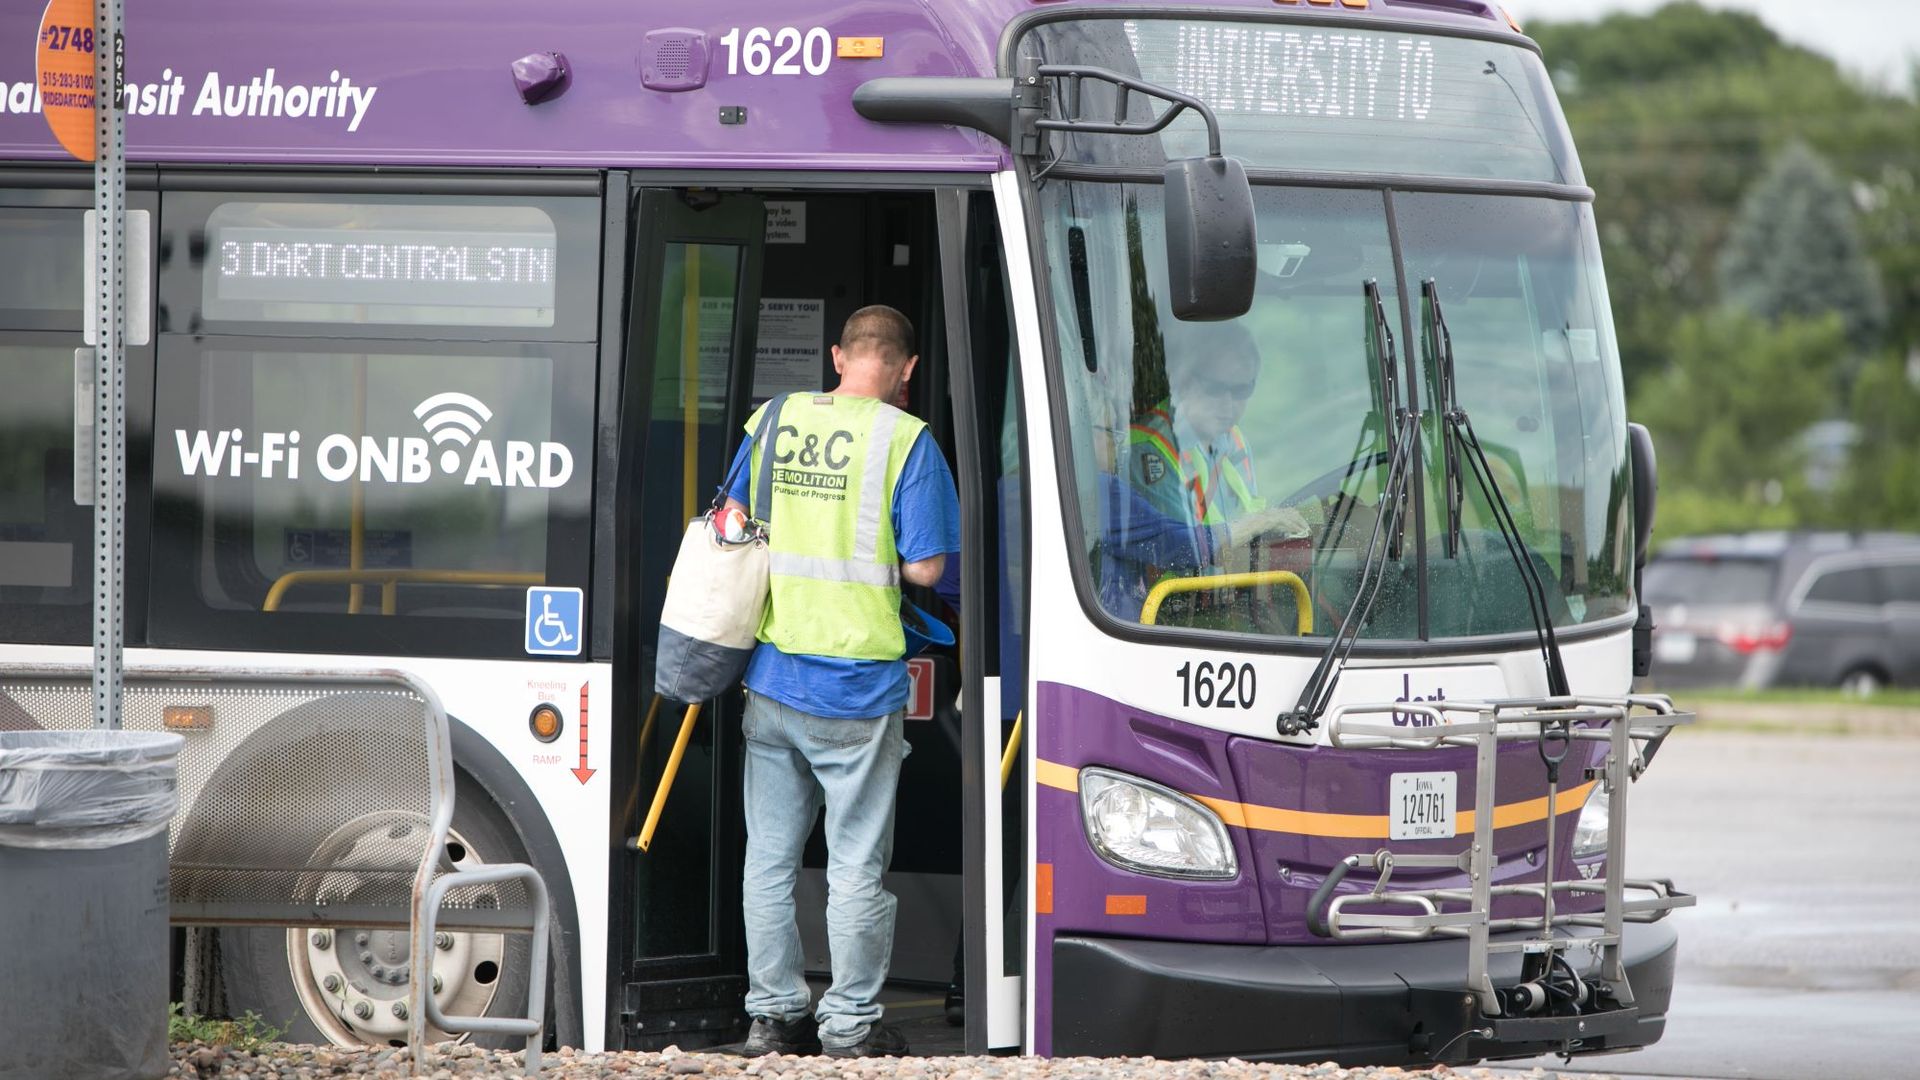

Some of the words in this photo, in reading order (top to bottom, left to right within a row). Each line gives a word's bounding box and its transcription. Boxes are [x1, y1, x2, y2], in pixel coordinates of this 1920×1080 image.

[41, 25, 94, 53] #2748
[720, 27, 832, 76] 1620
[43, 72, 94, 90] 515-283-8100
[115, 38, 124, 103] 2957
[1177, 26, 1385, 117] UNIVERSITY
[1398, 39, 1434, 120] TO
[124, 68, 185, 116] nsit
[192, 68, 377, 132] Authority
[768, 208, 779, 217] ay
[766, 230, 792, 241] ystem.
[221, 241, 240, 276] 3
[252, 242, 333, 278] DART
[341, 244, 478, 281] CENTRAL
[487, 247, 549, 282] STN
[175, 427, 300, 480] Wi-Fi
[773, 425, 854, 470] C&C
[774, 486, 800, 497] Pursuit
[811, 490, 846, 501] Progress
[527, 680, 567, 692] Kneeling
[538, 692, 556, 701] Bus
[1176, 661, 1257, 709] 1620
[533, 755, 562, 765] RAMP
[1403, 793, 1445, 824] 124761
